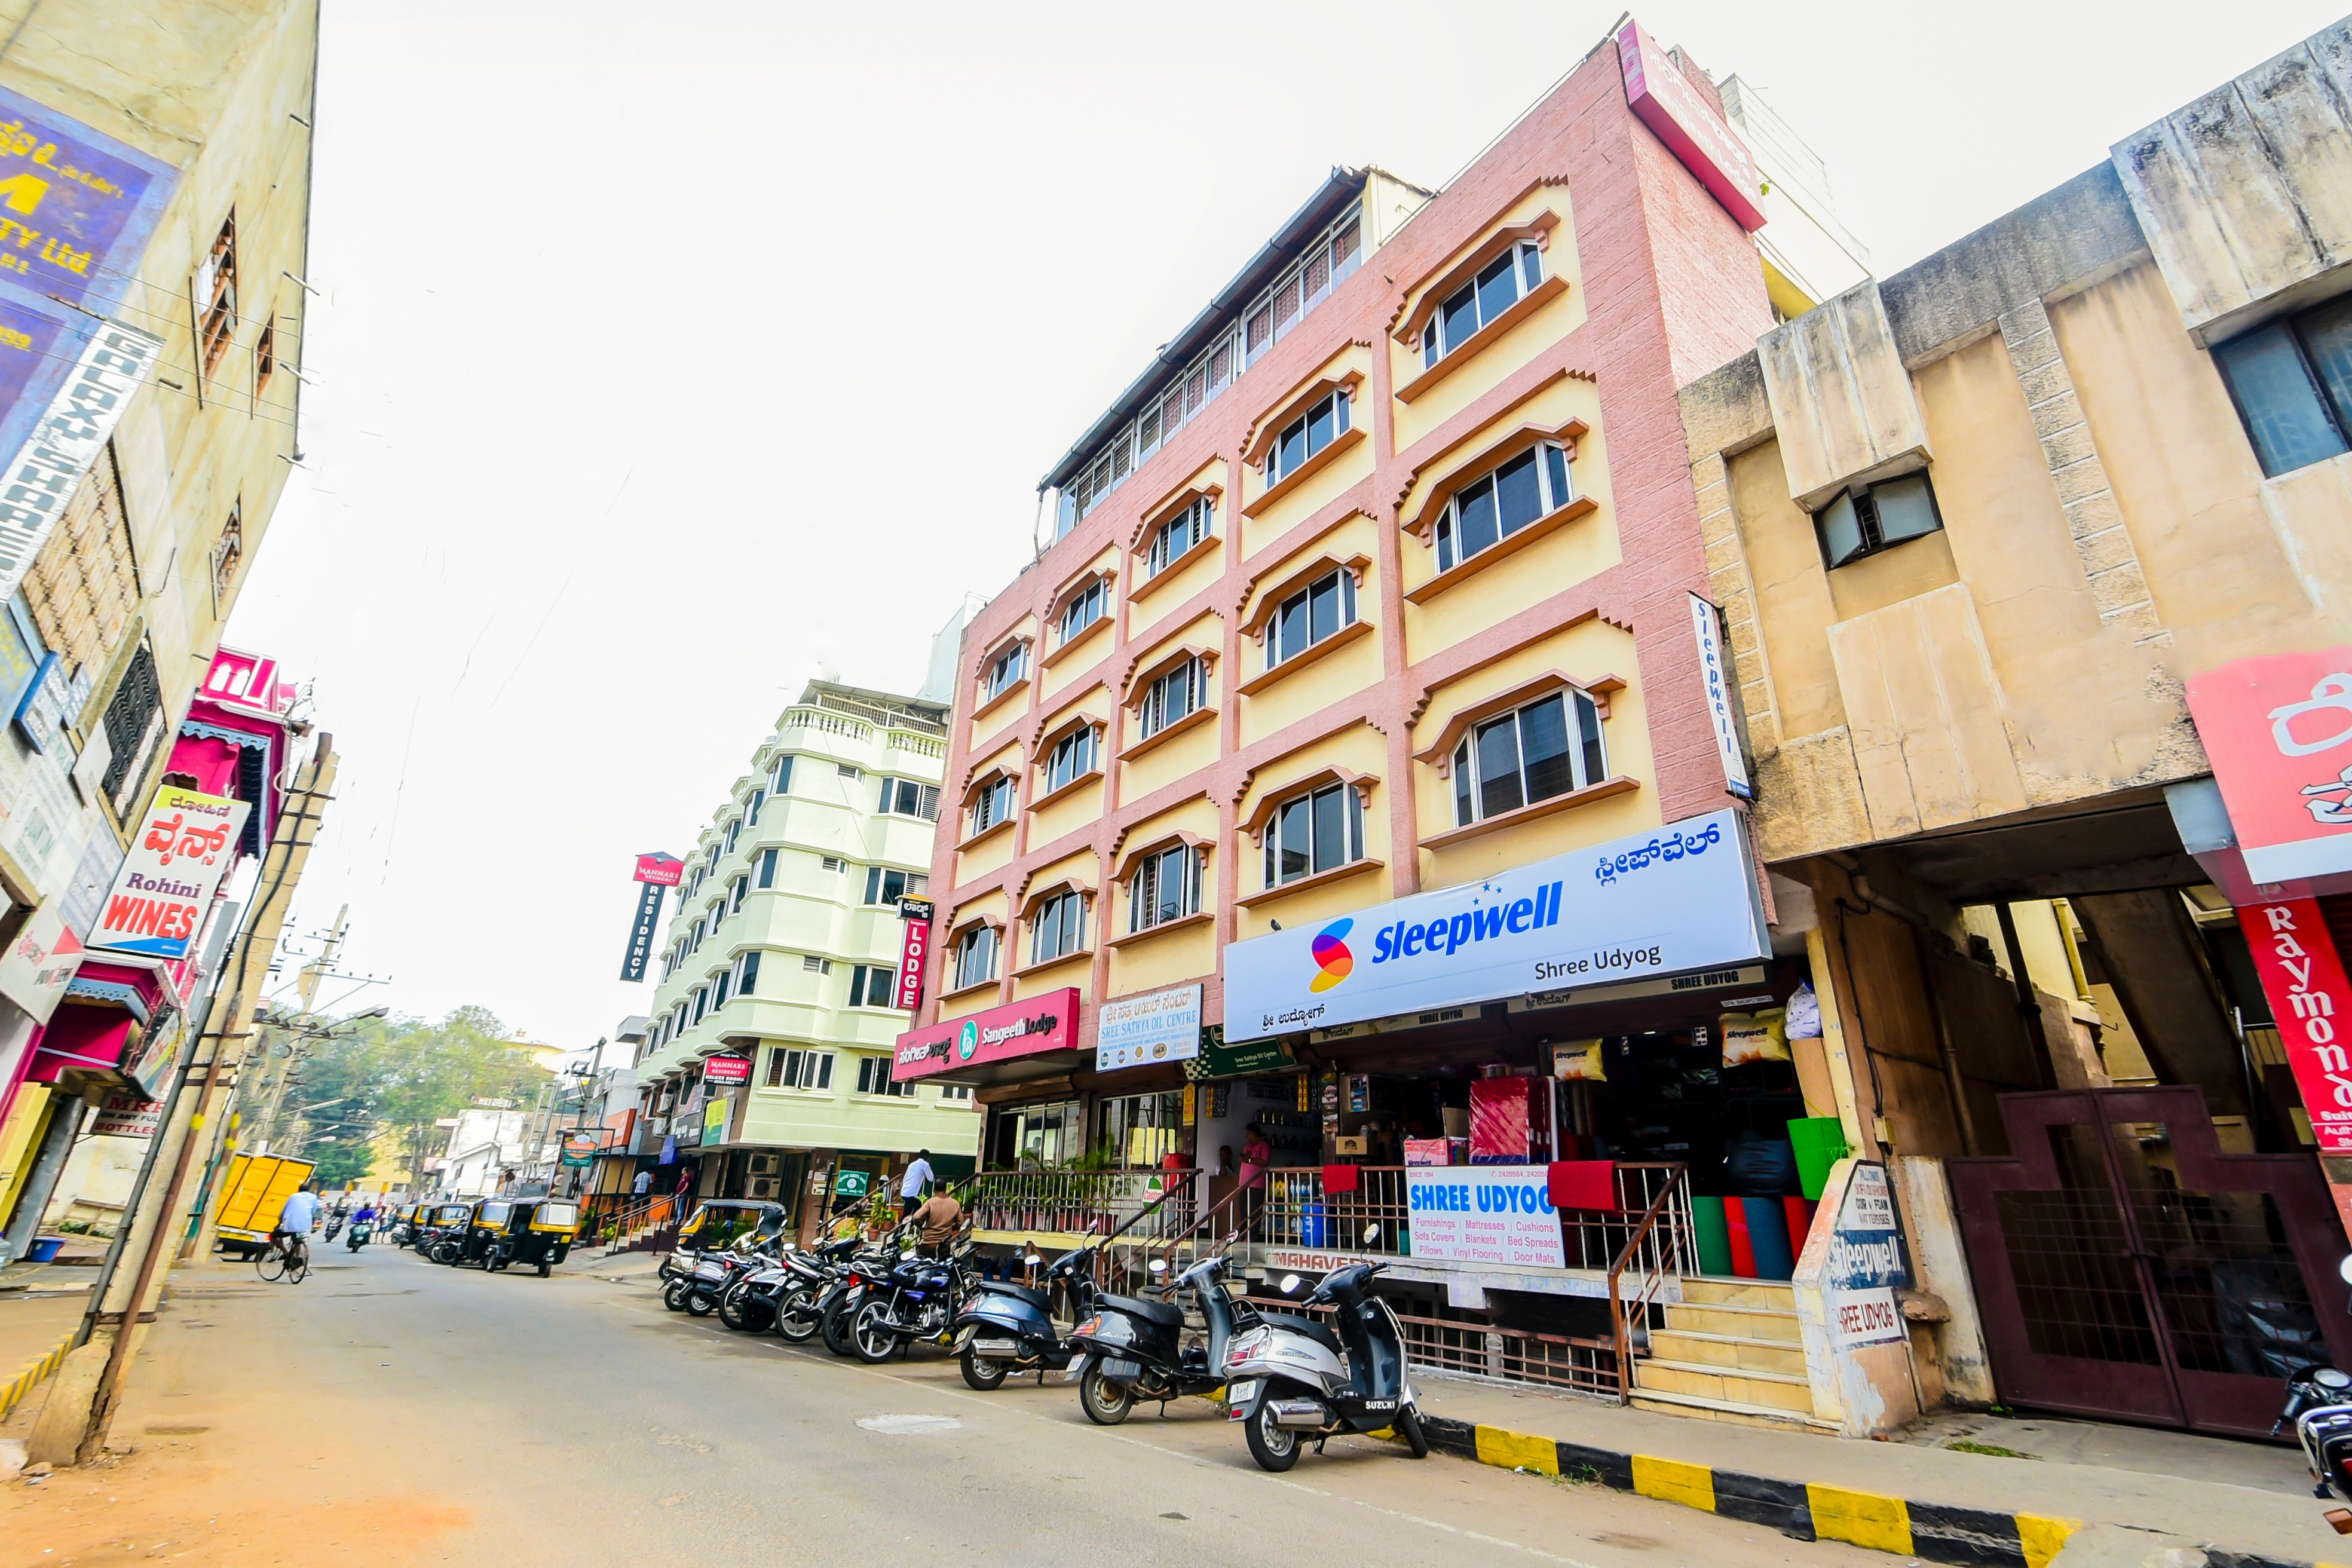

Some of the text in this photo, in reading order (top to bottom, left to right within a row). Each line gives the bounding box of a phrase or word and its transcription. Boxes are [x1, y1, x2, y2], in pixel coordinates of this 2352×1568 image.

[1698, 602, 1732, 754] Sleepwell
[144, 813, 231, 866] ವೈನ್ಸ್
[126, 872, 203, 898] Rohini
[638, 866, 679, 879] MANNARS
[645, 874, 677, 883] RESIDENCY
[103, 895, 198, 941] WINES
[1371, 880, 1564, 964] Sleepwell
[629, 885, 659, 978] RESIDENCY
[903, 927, 922, 1006] LODGE
[1535, 944, 1662, 981] Shree Udyog
[1671, 970, 1740, 990] SHREE UDYOG
[1263, 1004, 1325, 1031] ಶ್ರೀ ಉದ್ಯೋಗ್
[1419, 1009, 1463, 1025] SHREE UDYOG
[2262, 905, 2352, 1108] Raymond
[982, 1013, 1058, 1046] Sangeeth Lodge
[1101, 1024, 1119, 1039] SREE
[1121, 1018, 1150, 1036] SATHYA
[1152, 1016, 1164, 1030] OIL
[1167, 1010, 1197, 1027] CENTRE
[1726, 1027, 1769, 1039] Sleepwell
[710, 1060, 746, 1070] MANNARS
[1555, 1049, 1588, 1059] Sleepwell
[1858, 1168, 1881, 1183] PILLOWS
[1411, 1184, 1471, 1212] SHREE
[1855, 1198, 1867, 1210] COIR
[1875, 1198, 1889, 1211] FOAM
[1416, 1218, 1554, 1233] Furnishings Mattresses Cushions
[1414, 1231, 1558, 1249] Sofa Covers Blankets Bed Spreads
[1419, 1245, 1555, 1264] Pillows Vinyl Flooring Door Mats
[1828, 1235, 1901, 1282] Sleepwell
[1861, 1301, 1894, 1331] UDYOG
[1365, 1401, 1395, 1410] SUZUKI
